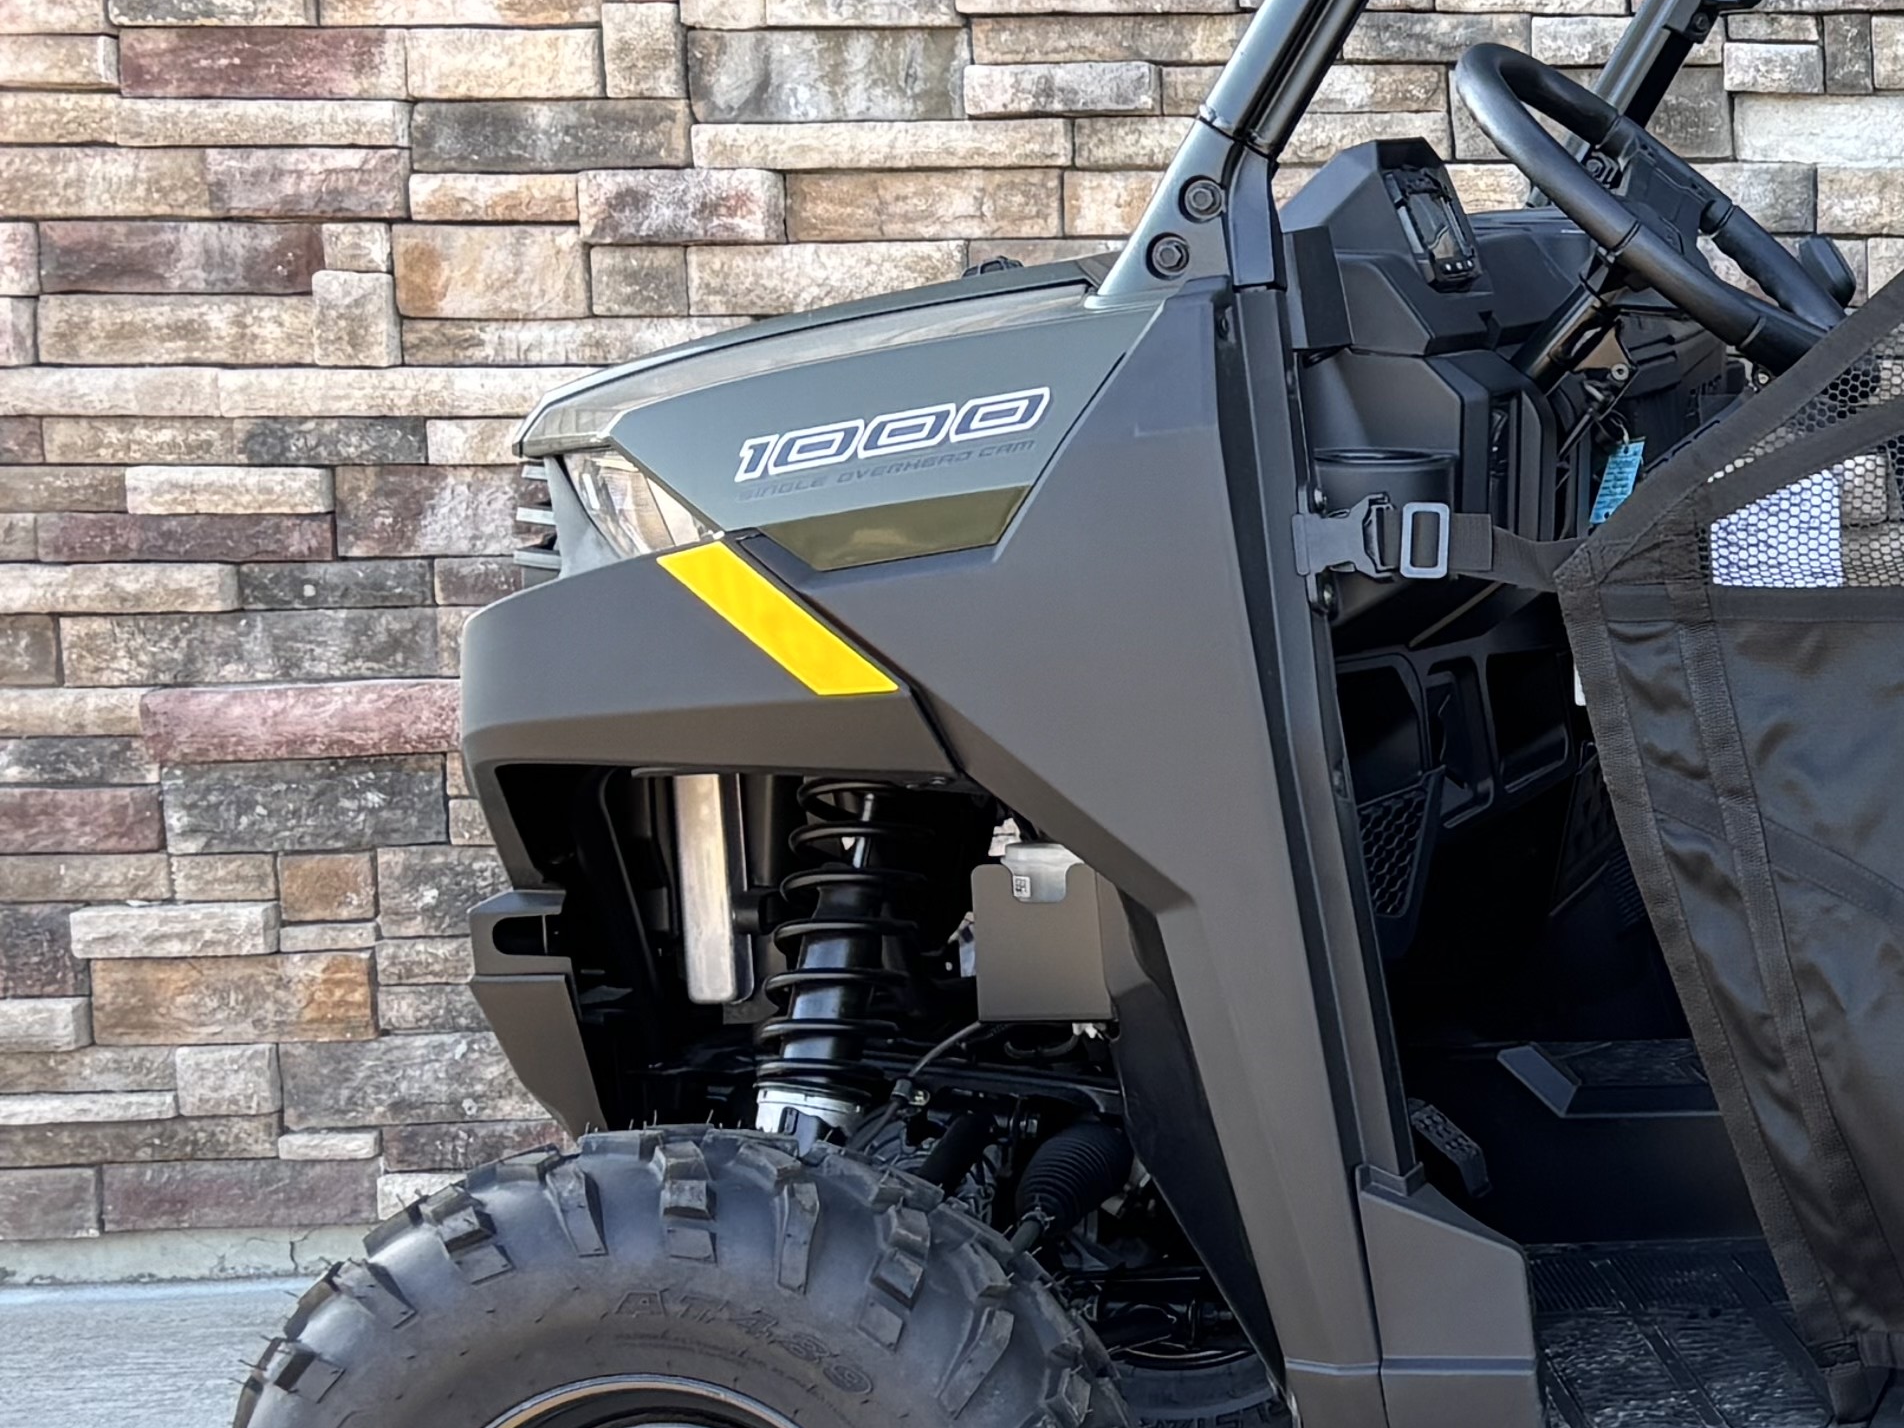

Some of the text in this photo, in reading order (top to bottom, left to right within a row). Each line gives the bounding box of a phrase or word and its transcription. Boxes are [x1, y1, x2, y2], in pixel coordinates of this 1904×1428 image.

[733, 386, 1050, 483] 1000
[737, 438, 1036, 501] SINGLE OVERHEAD CAM
